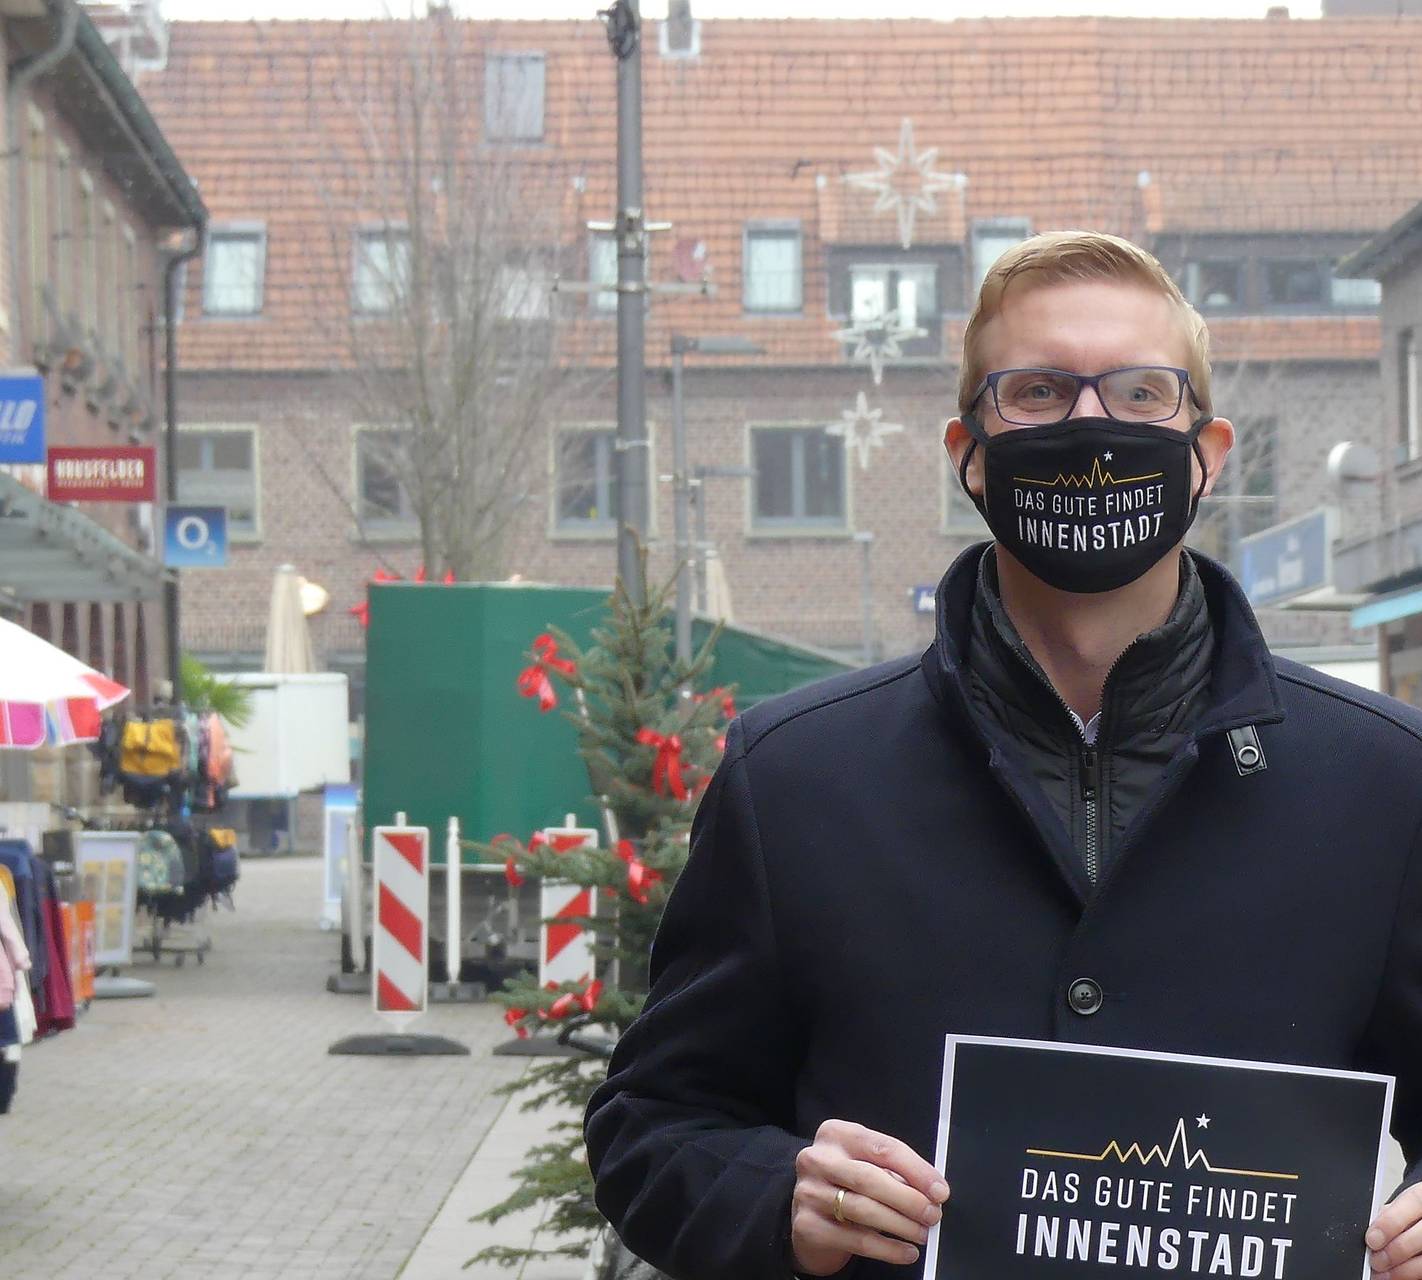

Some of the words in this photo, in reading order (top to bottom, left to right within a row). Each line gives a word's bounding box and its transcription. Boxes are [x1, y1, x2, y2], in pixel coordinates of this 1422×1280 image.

[1014, 488, 1045, 510] DAS
[1052, 494, 1097, 517] GUTE
[1105, 484, 1164, 513] FINDET
[1017, 511, 1165, 552] INNENSTADT
[1021, 1168, 1080, 1203] DAS
[1095, 1176, 1172, 1214] GUTE
[1187, 1184, 1297, 1224] FINDET
[1016, 1213, 1293, 1280] INNENSTADT
